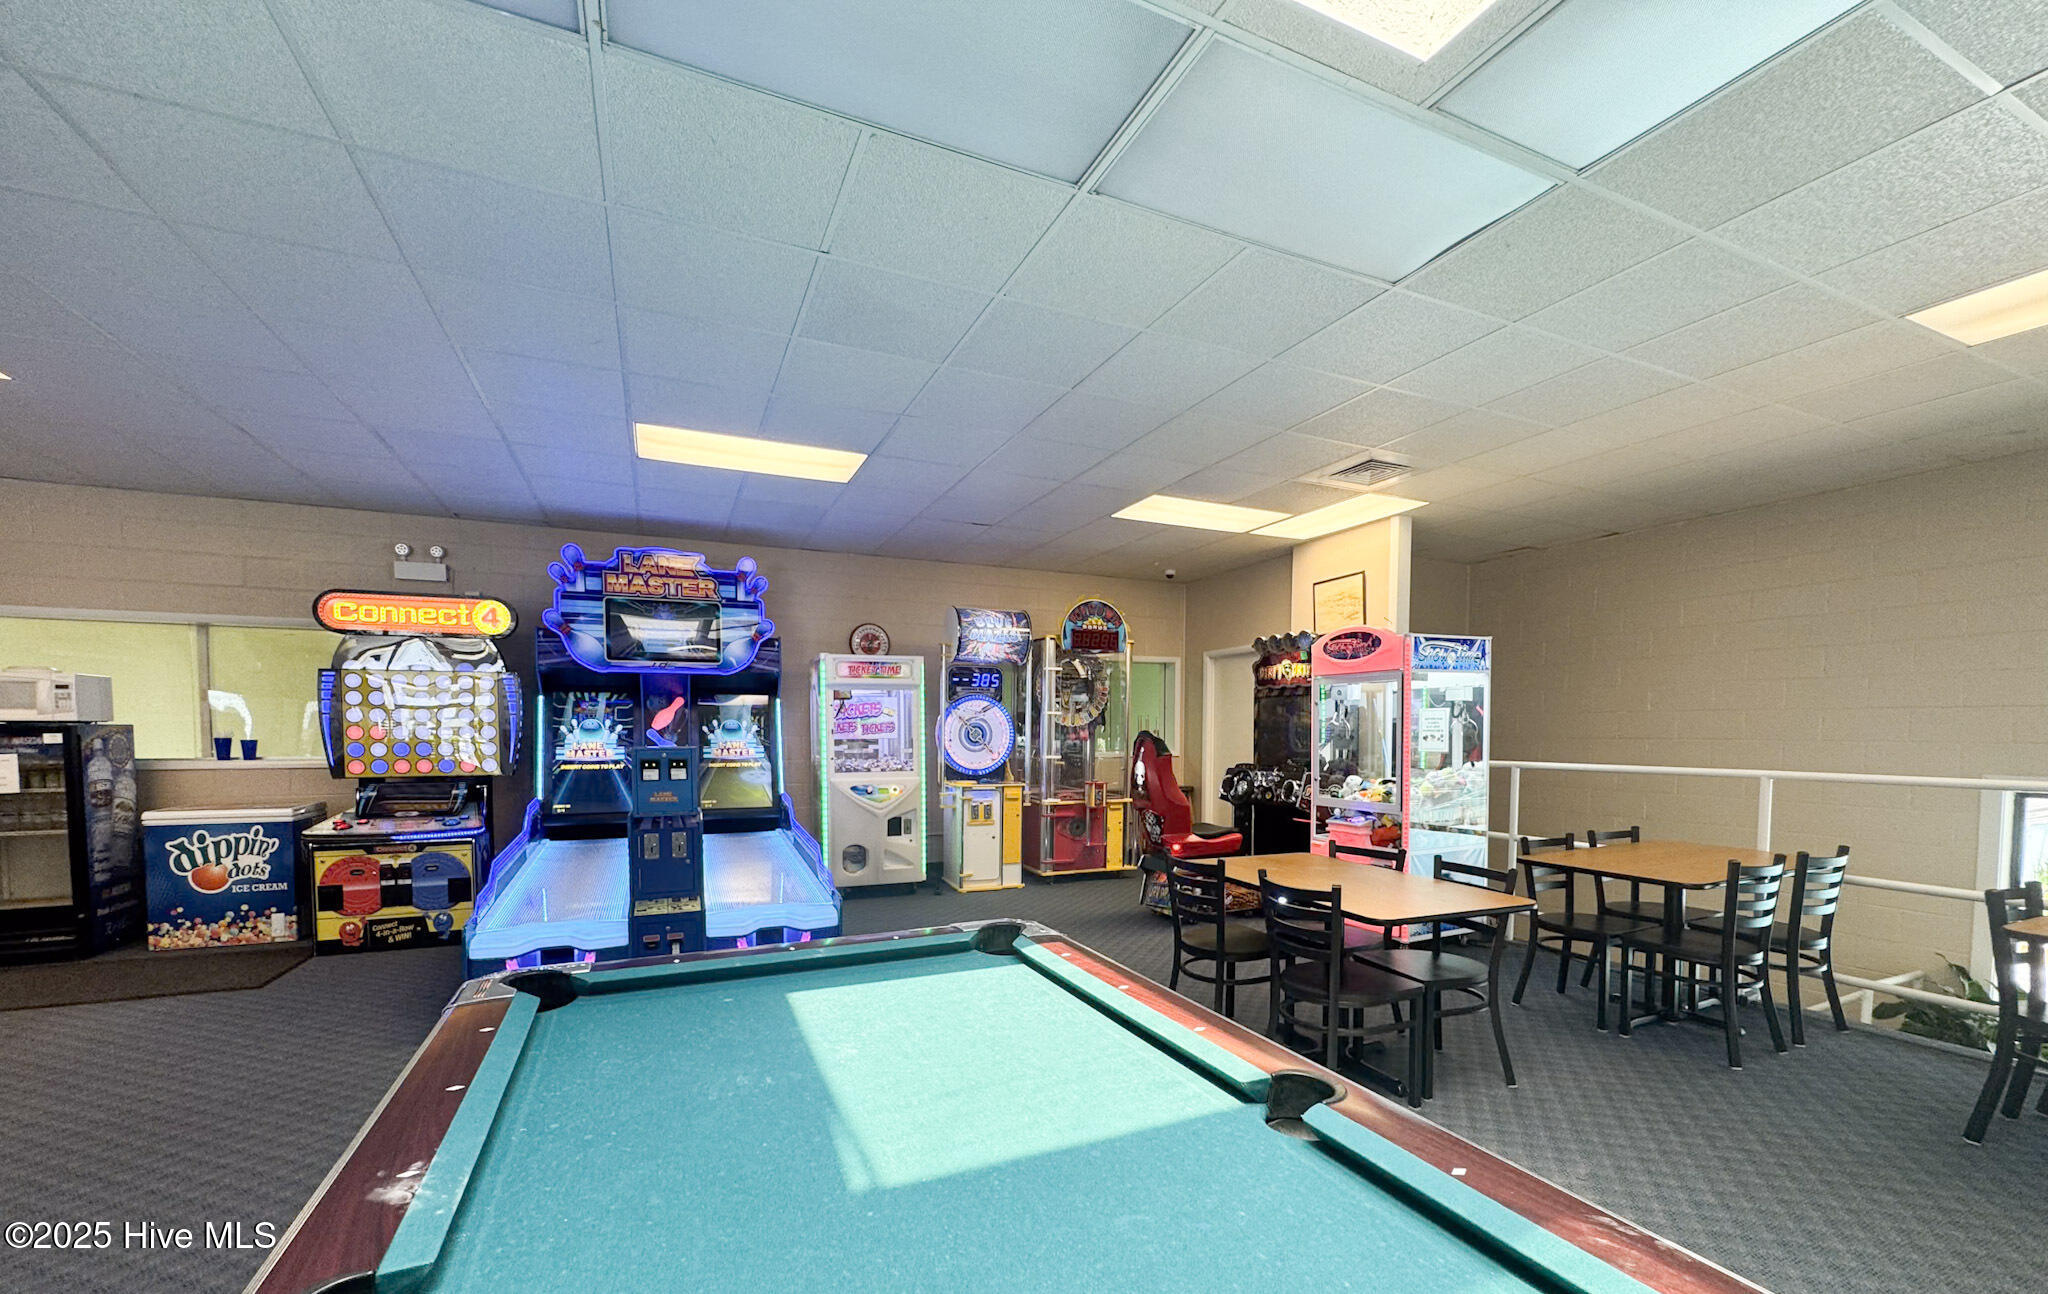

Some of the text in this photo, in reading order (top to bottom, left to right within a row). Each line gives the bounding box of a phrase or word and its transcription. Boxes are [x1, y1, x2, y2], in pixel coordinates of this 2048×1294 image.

[621, 552, 700, 577] LANE
[604, 572, 718, 598] MASTER
[332, 601, 500, 629] Connect 4
[848, 665, 902, 676] TICKET TIME
[228, 862, 268, 878] dots
[231, 883, 288, 893] ICE CREAM
[372, 921, 398, 931] Connect
[395, 932, 412, 942] WIN!
